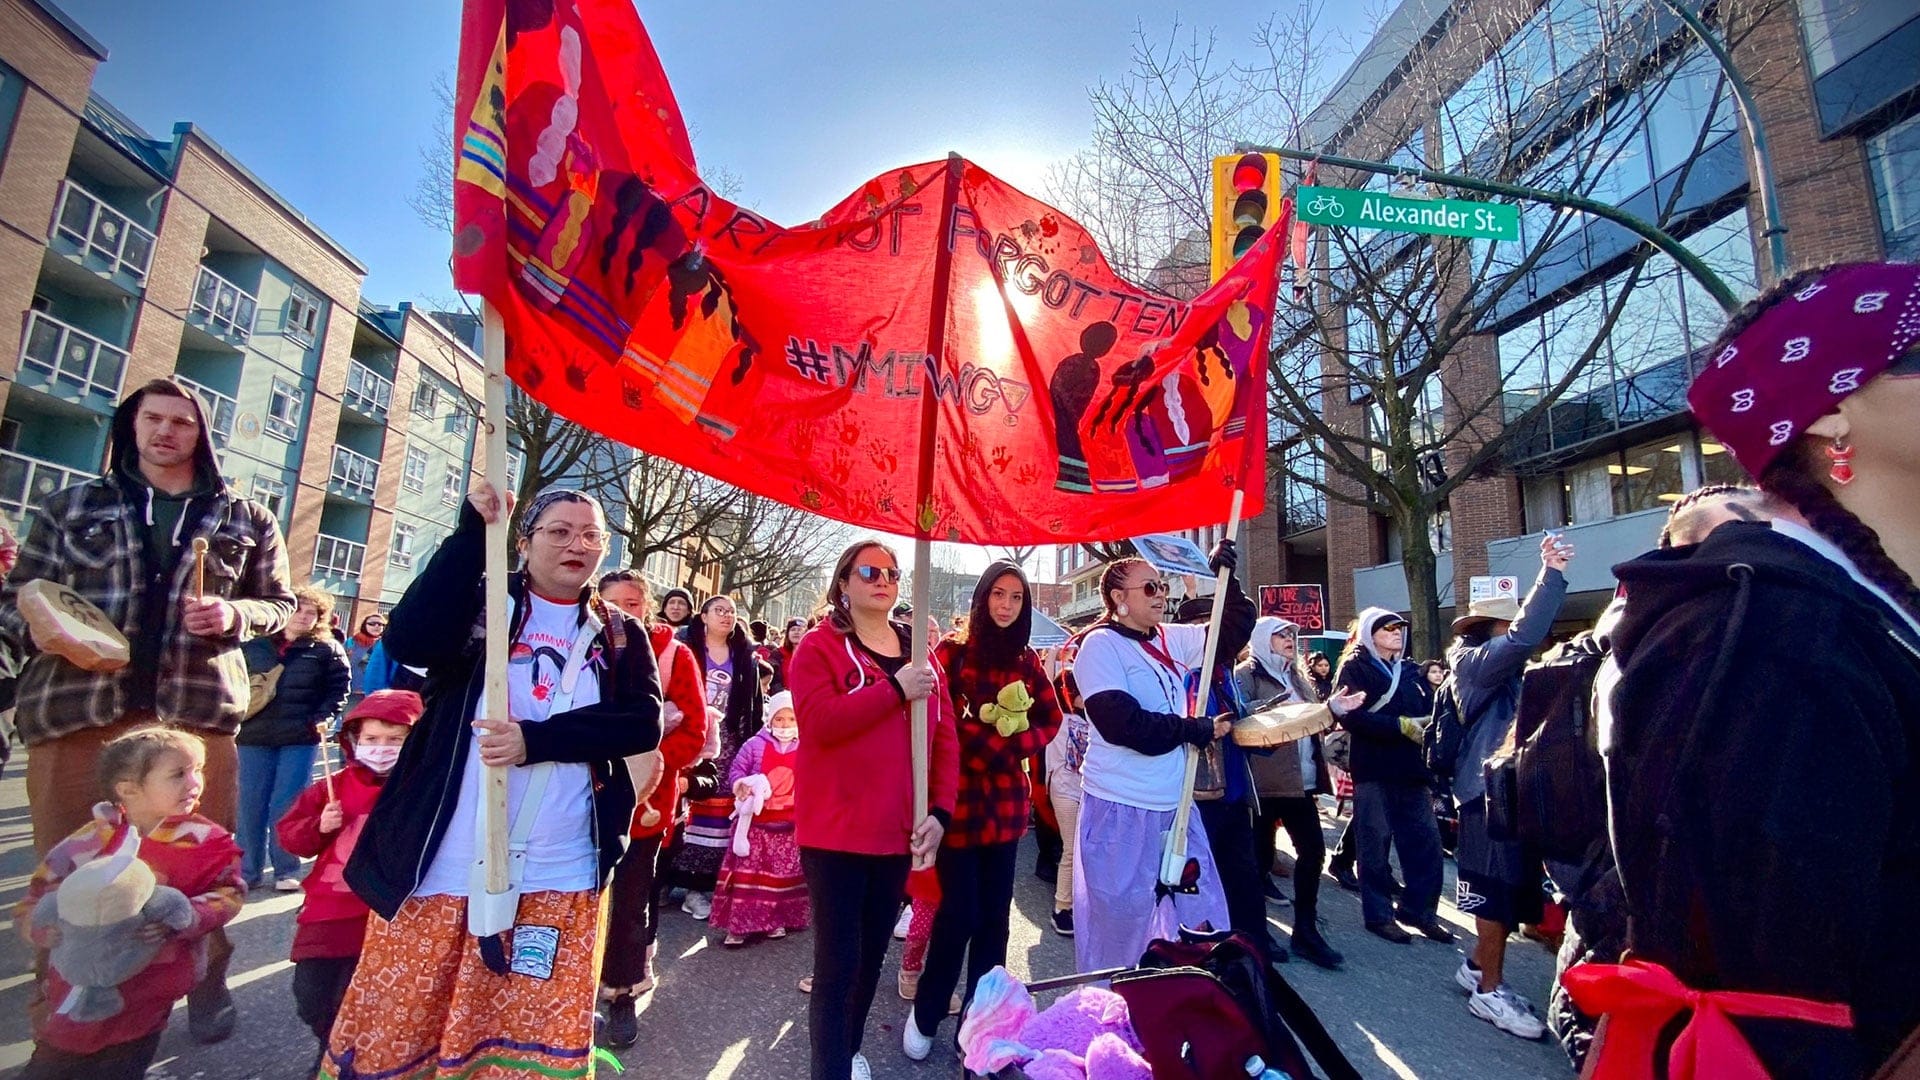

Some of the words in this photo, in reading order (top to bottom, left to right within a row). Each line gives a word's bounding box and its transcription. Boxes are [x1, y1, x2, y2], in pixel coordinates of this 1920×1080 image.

[1360, 198, 1469, 229] Alexander
[1474, 208, 1503, 232] St.
[814, 203, 922, 256] OT
[948, 202, 1192, 337] FORGOTTEN
[1273, 600, 1320, 614] STOLEN
